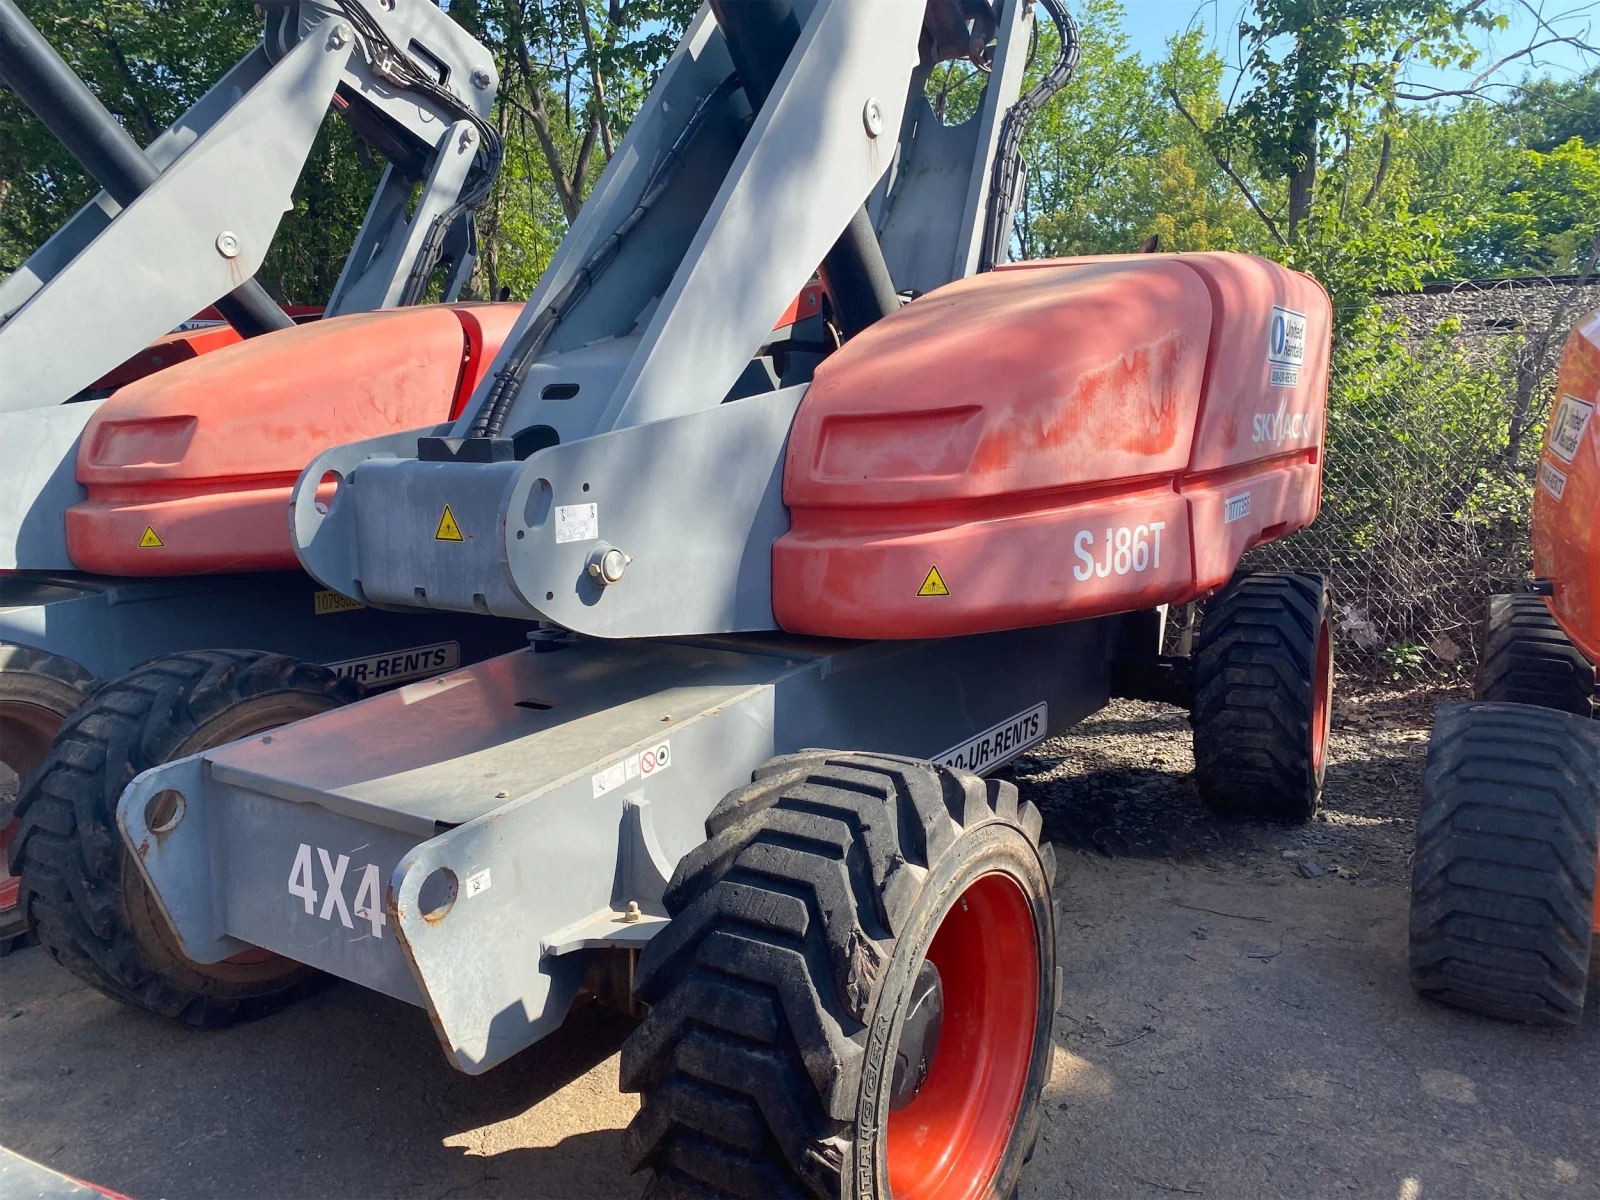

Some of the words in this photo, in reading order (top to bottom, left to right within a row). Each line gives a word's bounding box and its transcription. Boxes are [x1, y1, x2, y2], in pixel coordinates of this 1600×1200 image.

[1284, 340, 1302, 358] Rentals
[1286, 320, 1304, 339] United
[1252, 396, 1309, 448] SKYJACK
[1074, 522, 1165, 581] SJ86T
[288, 843, 387, 939] 4X4
